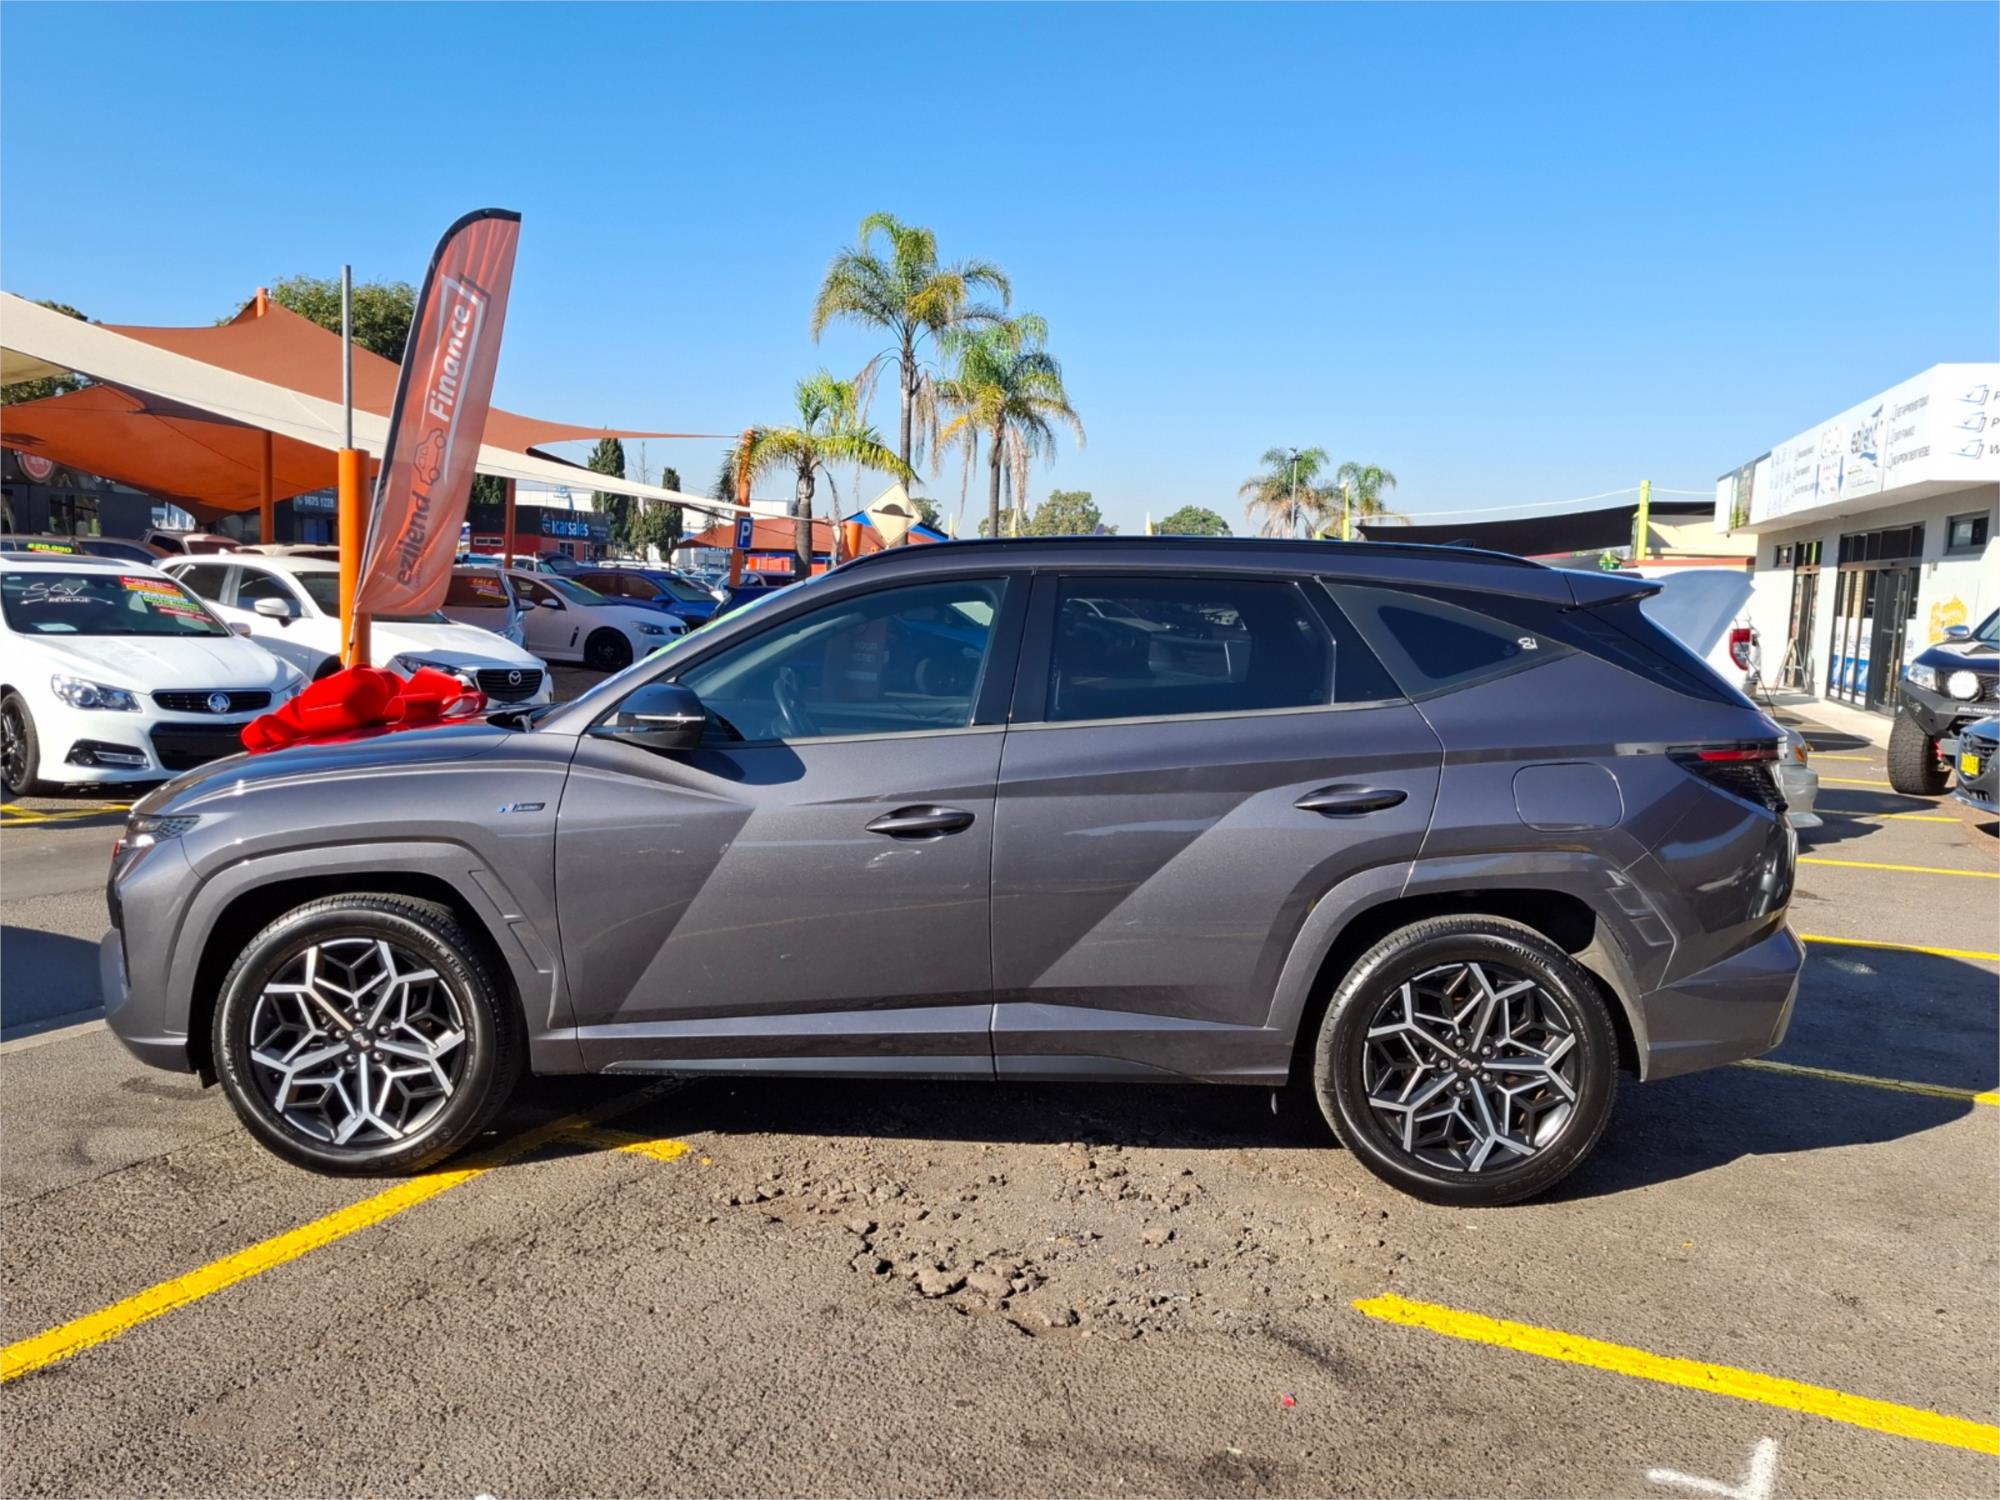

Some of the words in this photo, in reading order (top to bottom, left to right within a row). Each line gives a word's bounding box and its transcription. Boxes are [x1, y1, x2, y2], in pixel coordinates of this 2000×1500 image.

[428, 303, 471, 424] Finance
[396, 489, 432, 586] ezilend
[739, 520, 752, 545] P
